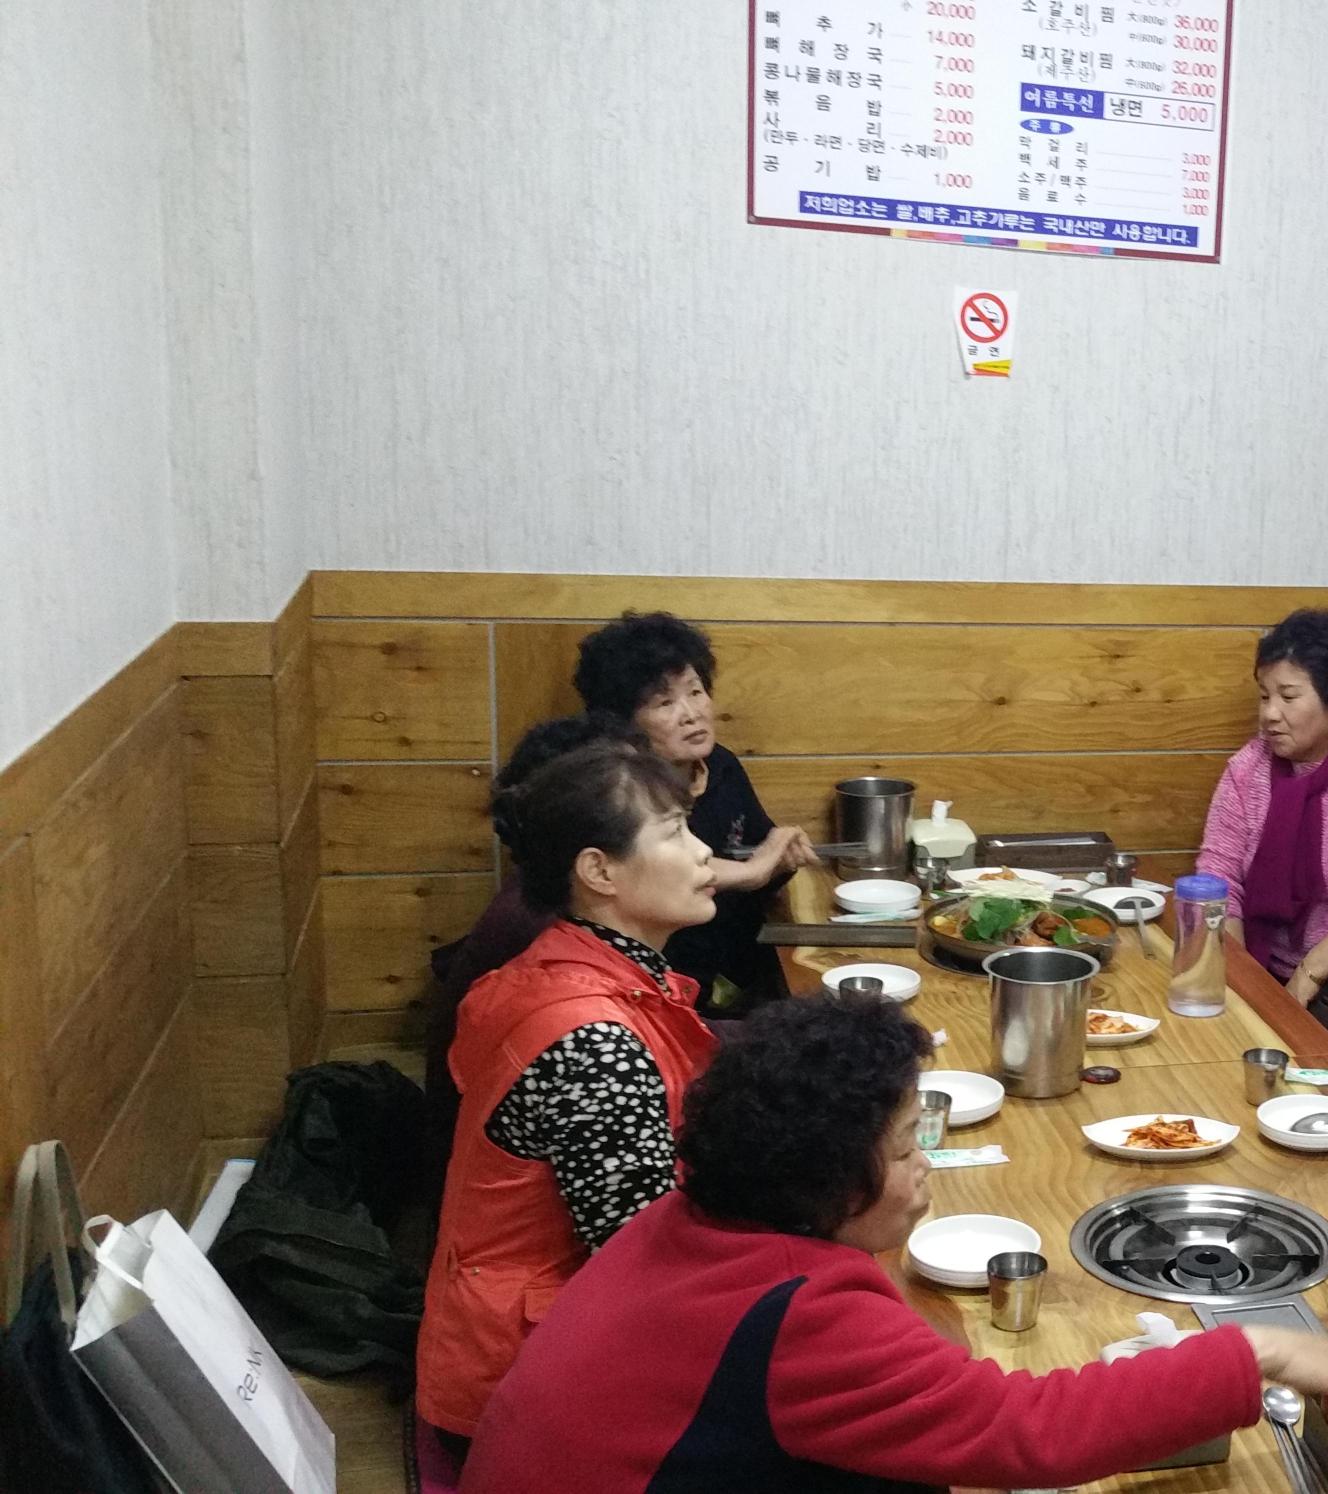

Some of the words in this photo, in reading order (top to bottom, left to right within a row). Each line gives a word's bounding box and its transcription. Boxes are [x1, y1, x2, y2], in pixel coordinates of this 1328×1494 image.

[927, 1, 975, 20] 20,000
[927, 30, 975, 48] 14,000
[934, 55, 975, 73] 7,000
[933, 81, 974, 99] 5,000
[933, 107, 974, 126] 2,000
[1110, 97, 1144, 119] 냉면
[933, 128, 974, 147] 2,000
[934, 173, 974, 189] 1,000
[804, 194, 888, 219] 저희업소는
[1043, 217, 1106, 239] 국내산만
